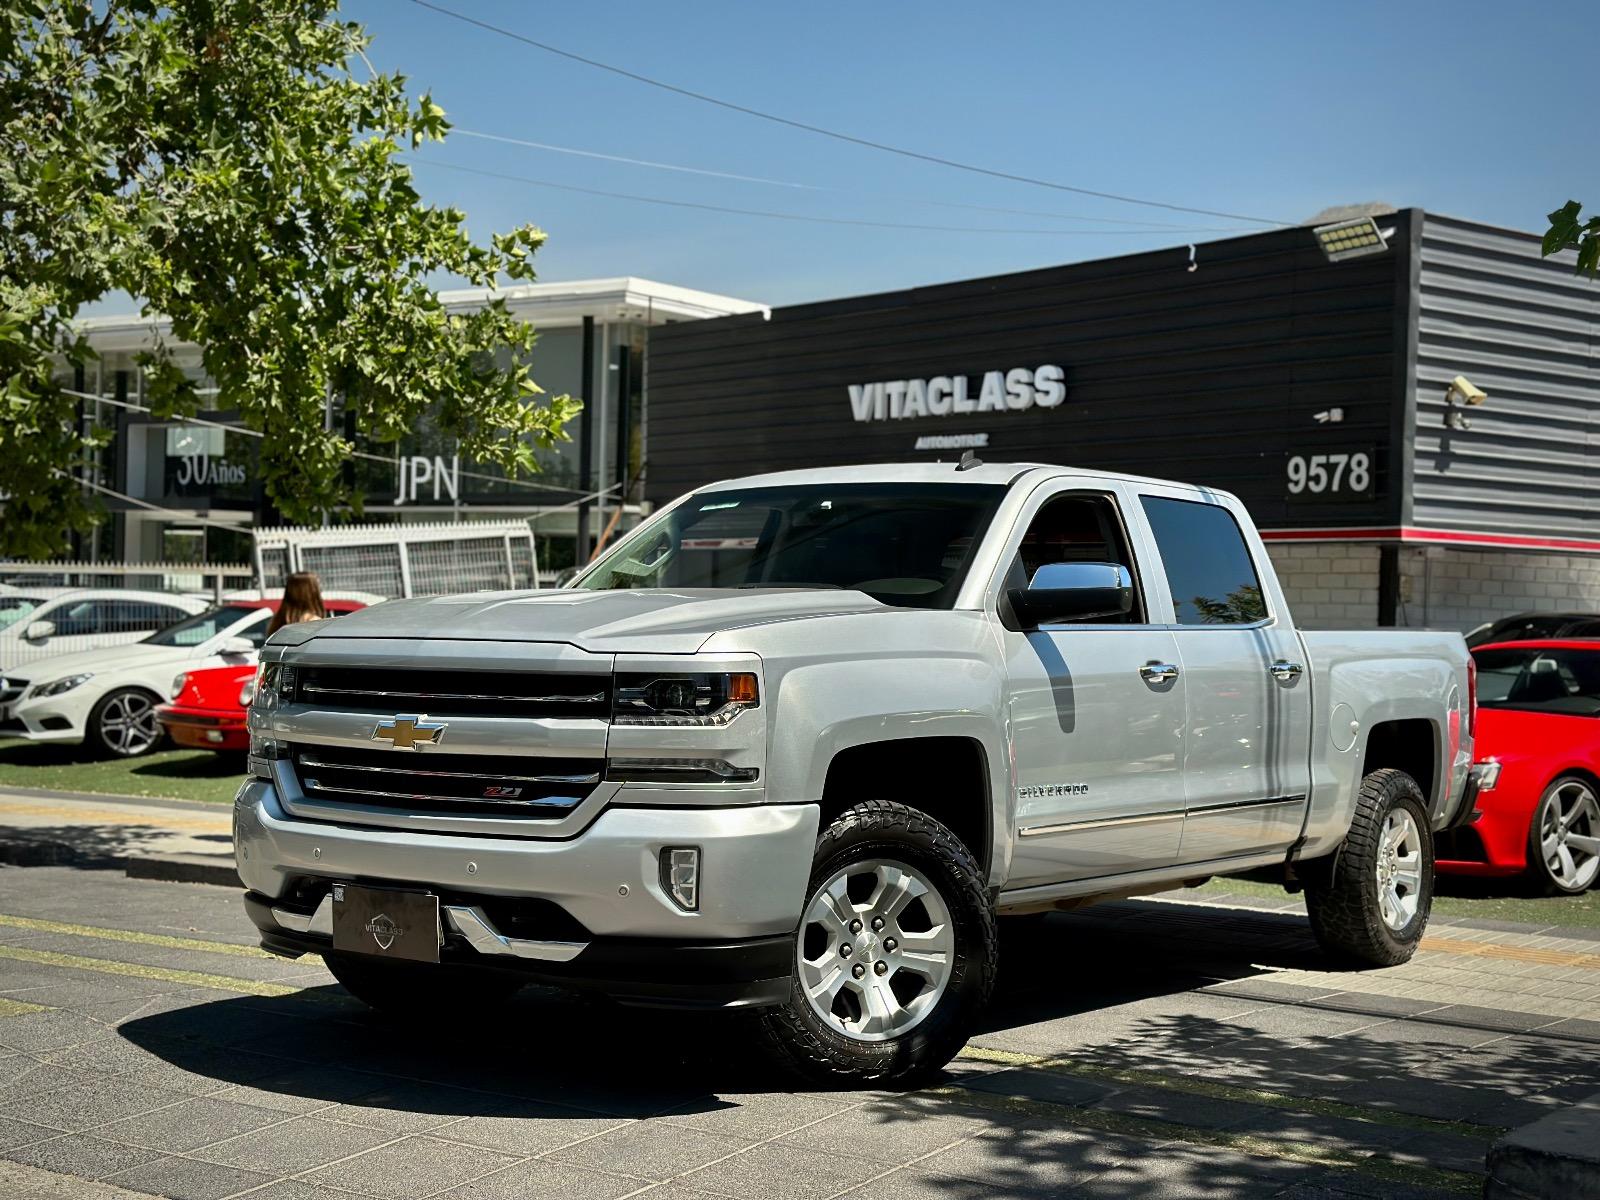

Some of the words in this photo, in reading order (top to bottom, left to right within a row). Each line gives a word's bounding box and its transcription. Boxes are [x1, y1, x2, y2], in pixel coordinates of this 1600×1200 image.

[848, 364, 1067, 422] VITACLASS
[206, 458, 247, 484] Años
[393, 455, 459, 506] JPN
[1286, 452, 1370, 494] 9578
[482, 786, 523, 798] Z71
